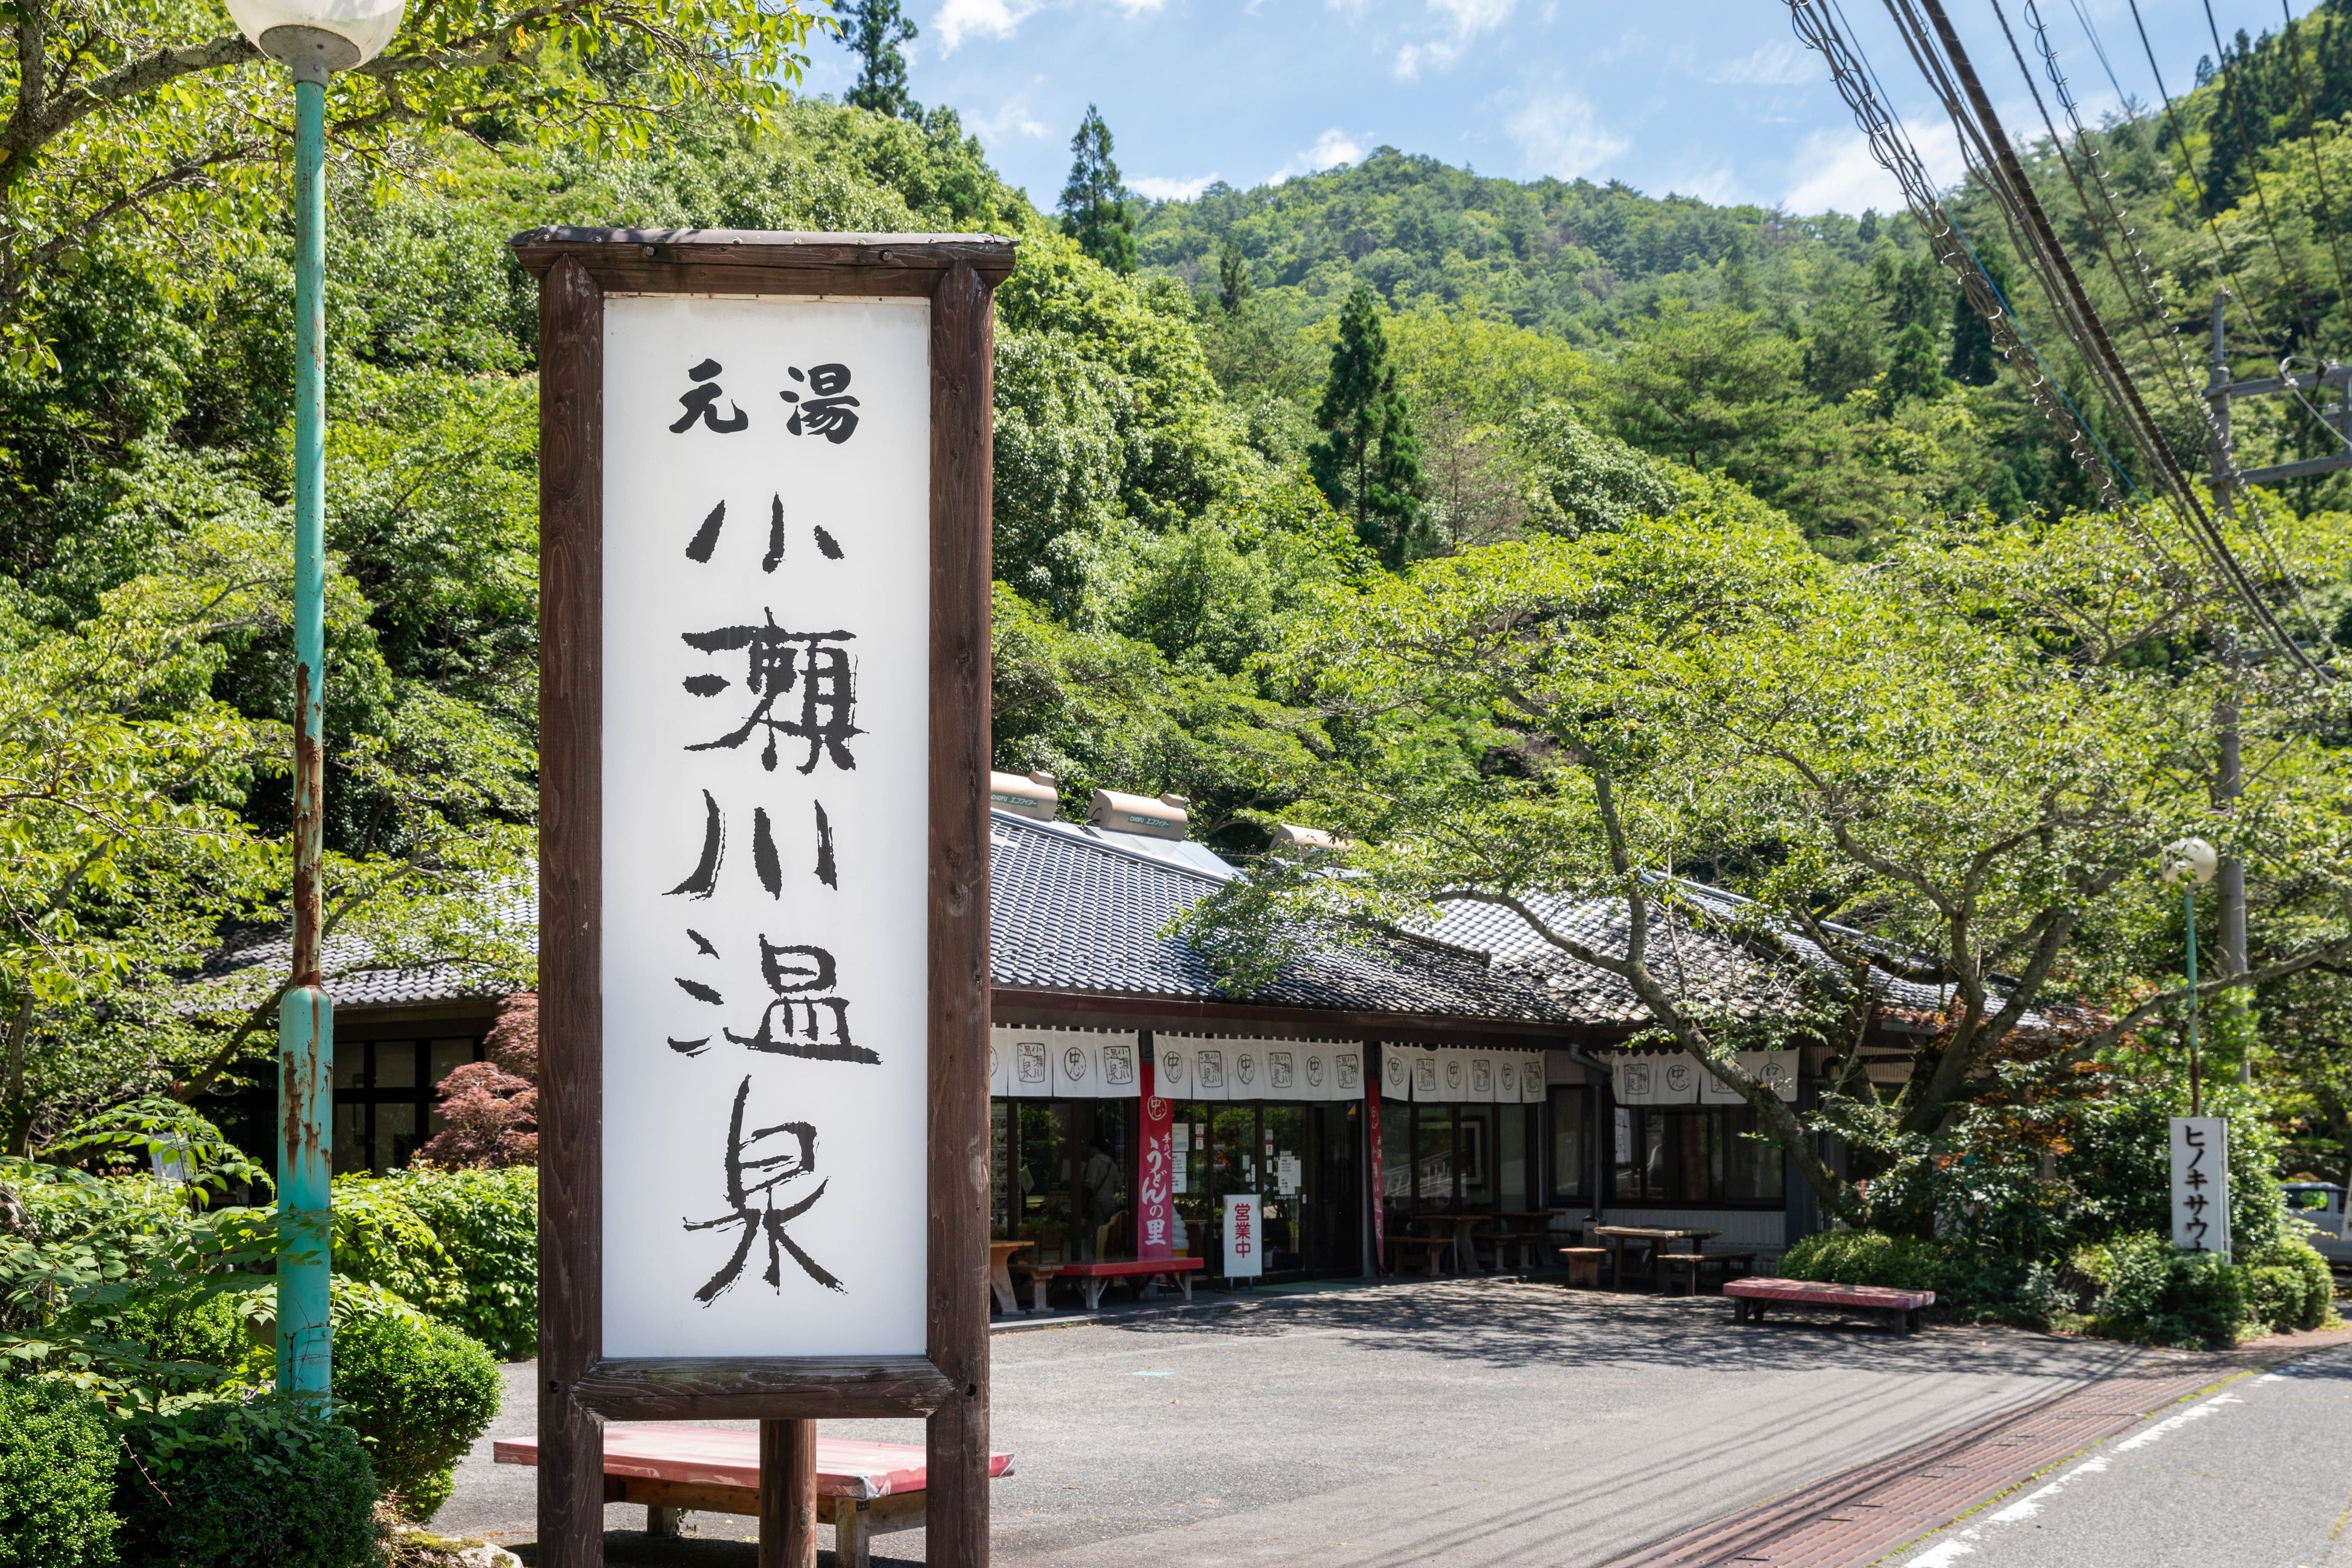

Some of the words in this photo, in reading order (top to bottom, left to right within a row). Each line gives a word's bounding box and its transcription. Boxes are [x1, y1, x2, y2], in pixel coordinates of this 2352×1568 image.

[662, 494, 883, 1309] 小瀬川温泉
[1142, 1136, 1168, 1245] うどんの里
[1234, 1203, 1251, 1259] 営業中
